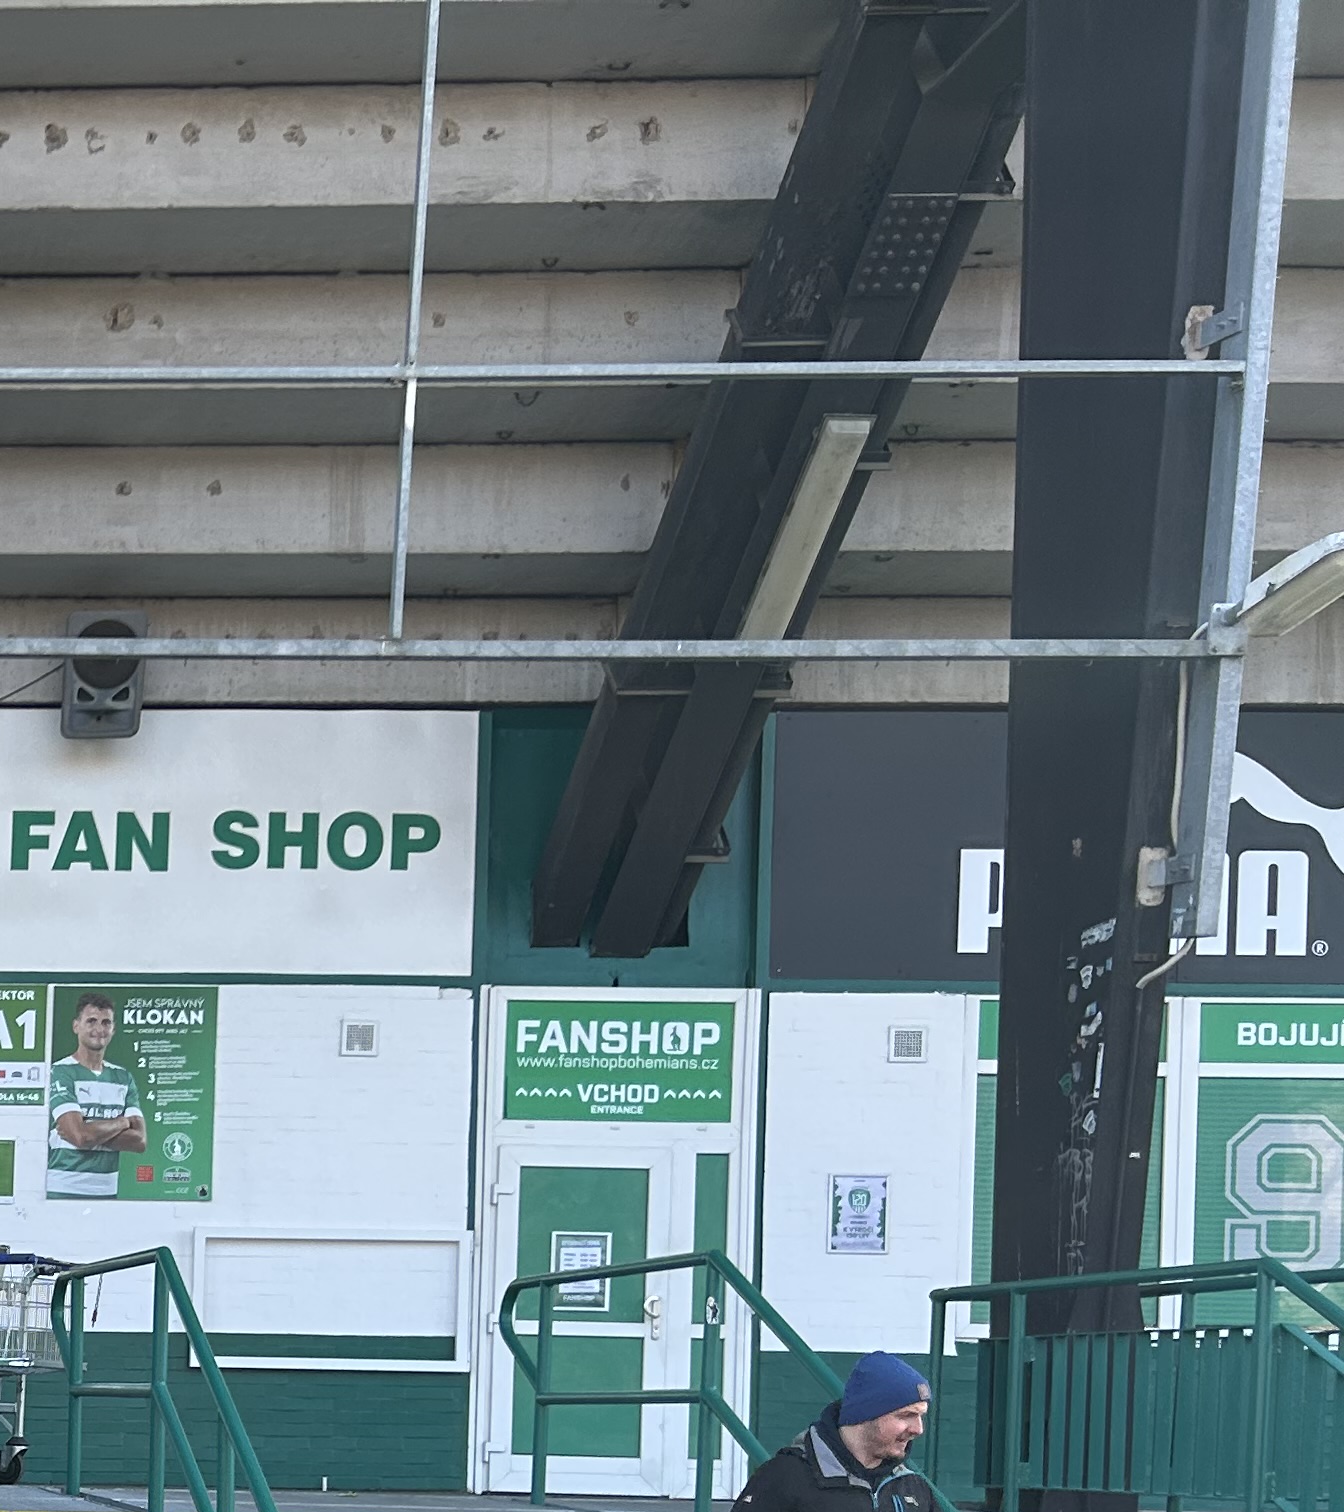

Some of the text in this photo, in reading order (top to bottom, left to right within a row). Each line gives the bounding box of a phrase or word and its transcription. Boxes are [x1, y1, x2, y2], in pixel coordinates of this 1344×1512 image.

[10, 810, 442, 872] FAN SHOP
[957, 848, 1310, 956] PA
[123, 996, 205, 1009] JSEM SPRÁVNÝ
[123, 1009, 204, 1025] KLOKAN
[516, 1019, 721, 1055] FANSHOP
[133, 1041, 139, 1052] 1
[137, 1057, 146, 1068] 2
[516, 1055, 719, 1071] www.fanshopbohemians.cz
[147, 1073, 155, 1084] 3
[146, 1090, 155, 1101] 4
[577, 1083, 660, 1104] VCHOD
[154, 1111, 162, 1122] 5
[590, 1105, 644, 1115] ENTRANCE
